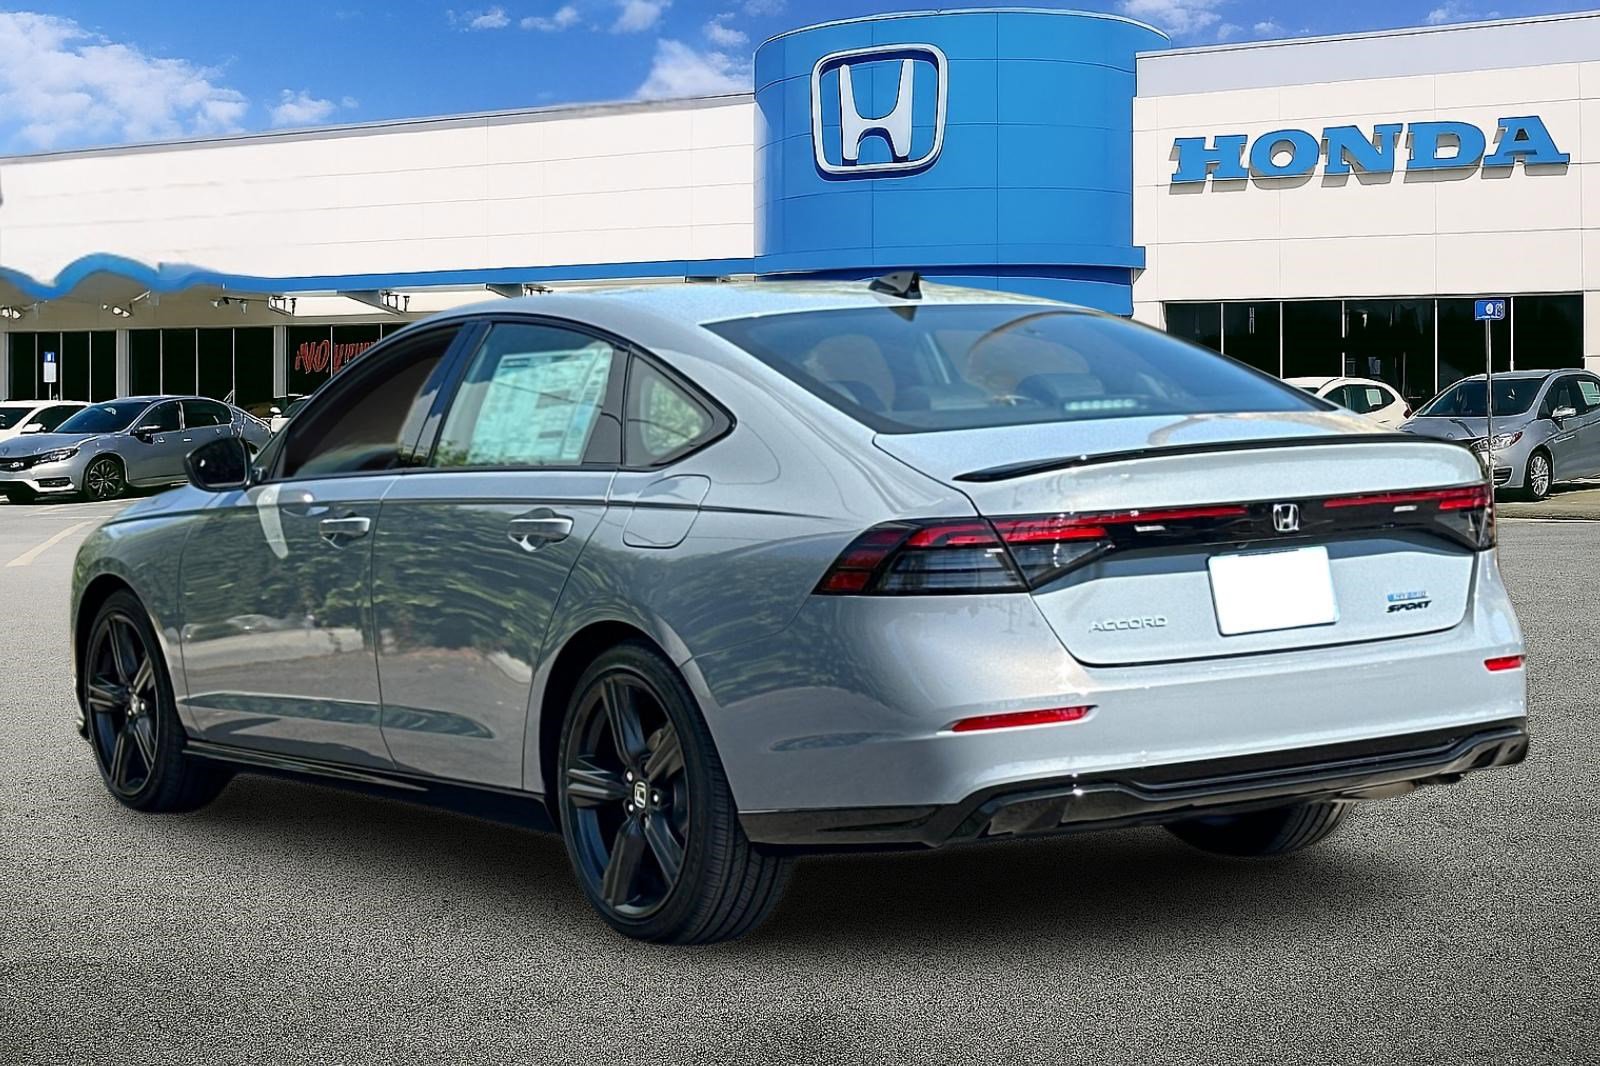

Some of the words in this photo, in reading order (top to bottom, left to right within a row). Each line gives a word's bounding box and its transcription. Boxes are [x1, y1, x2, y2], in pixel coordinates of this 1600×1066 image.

[1170, 115, 1571, 188] HONDA
[1386, 600, 1432, 613] SPORT
[1088, 615, 1168, 633] ACCORD
